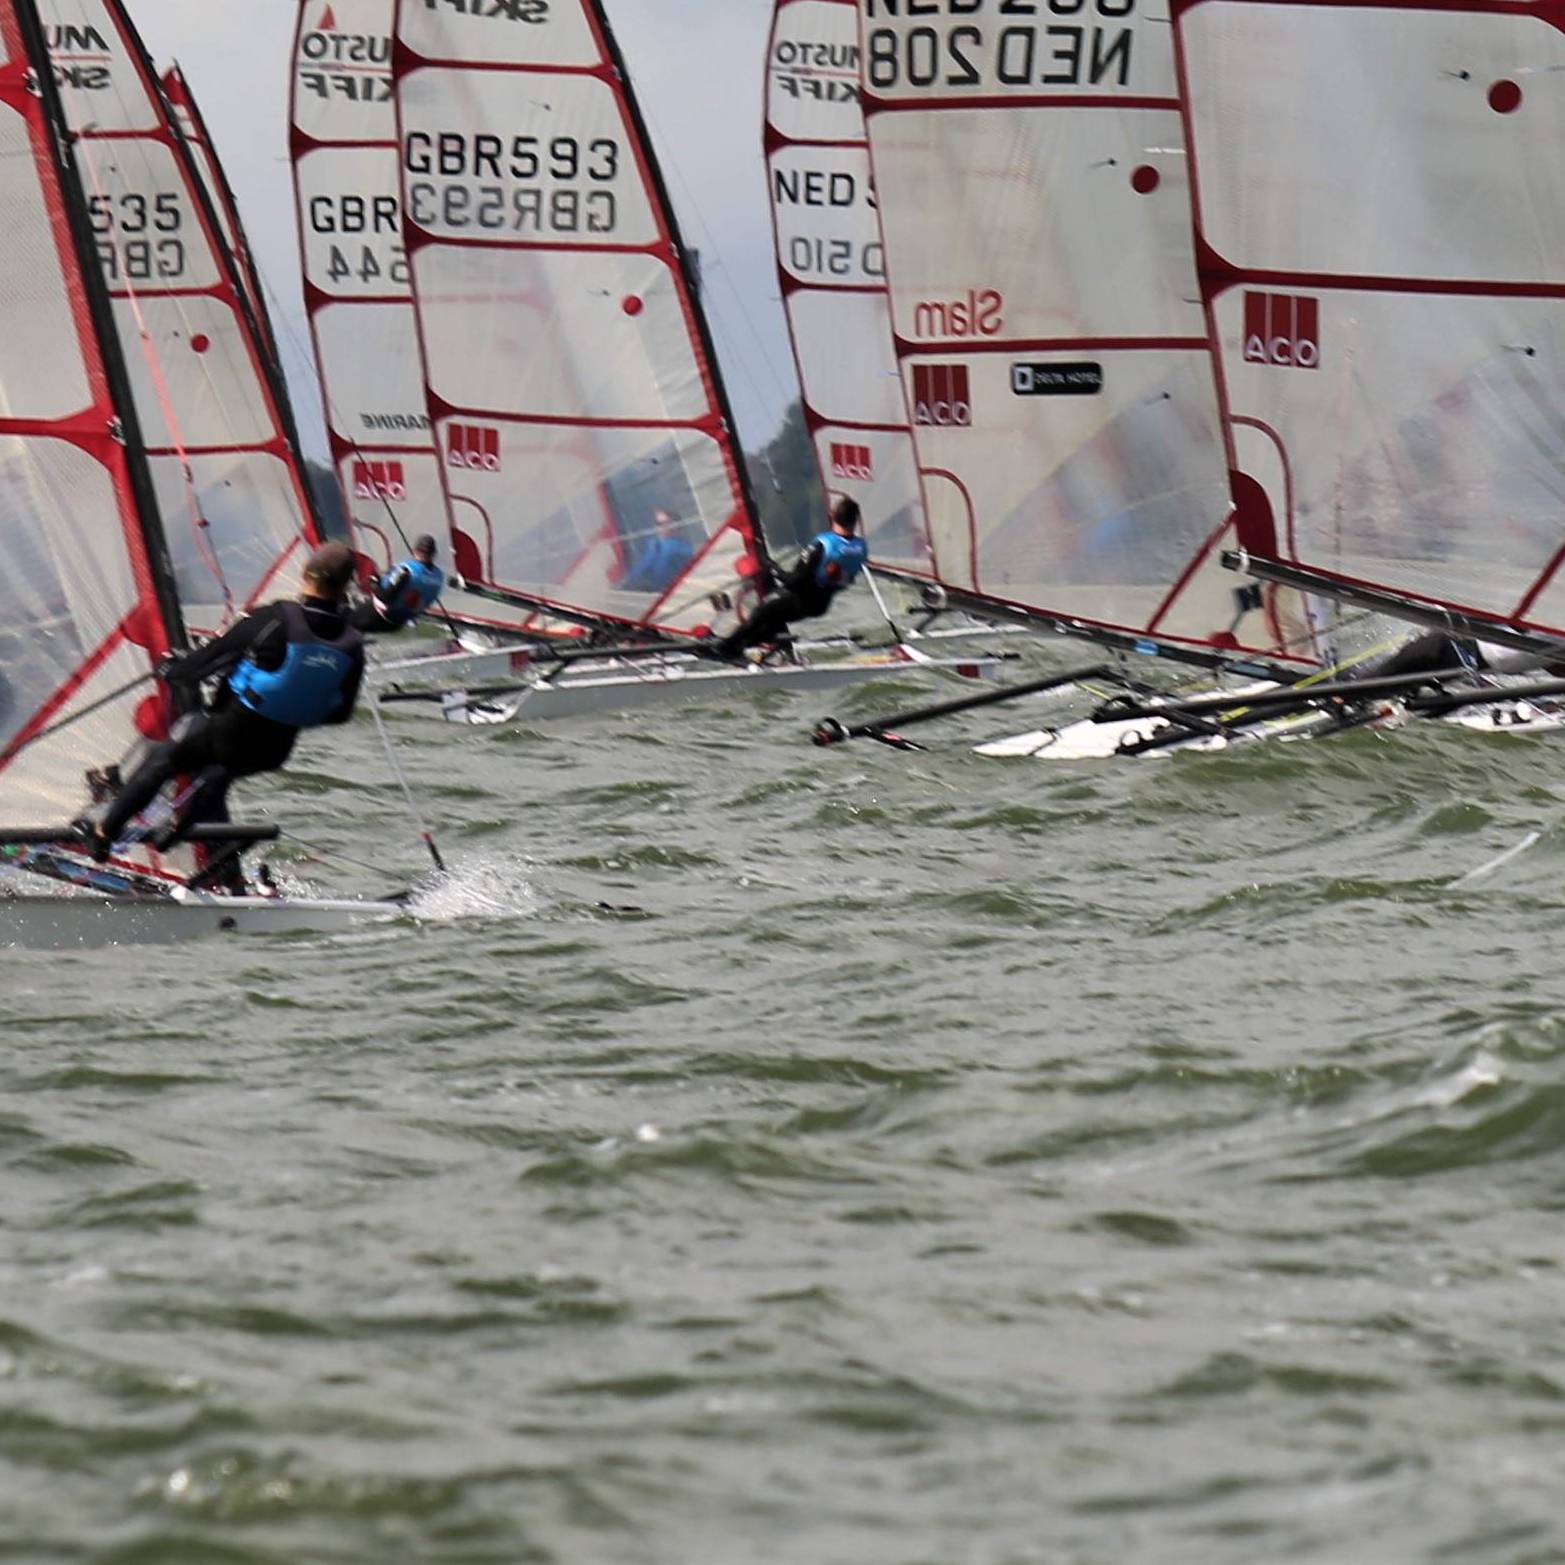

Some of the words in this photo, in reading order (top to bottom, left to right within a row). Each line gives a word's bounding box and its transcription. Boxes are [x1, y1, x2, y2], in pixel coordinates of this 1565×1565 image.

[406, 132, 618, 182] GBR593
[775, 169, 878, 210] NED
[310, 196, 399, 234] GBR
[1246, 333, 1319, 366] ACO
[916, 401, 971, 425] ACO
